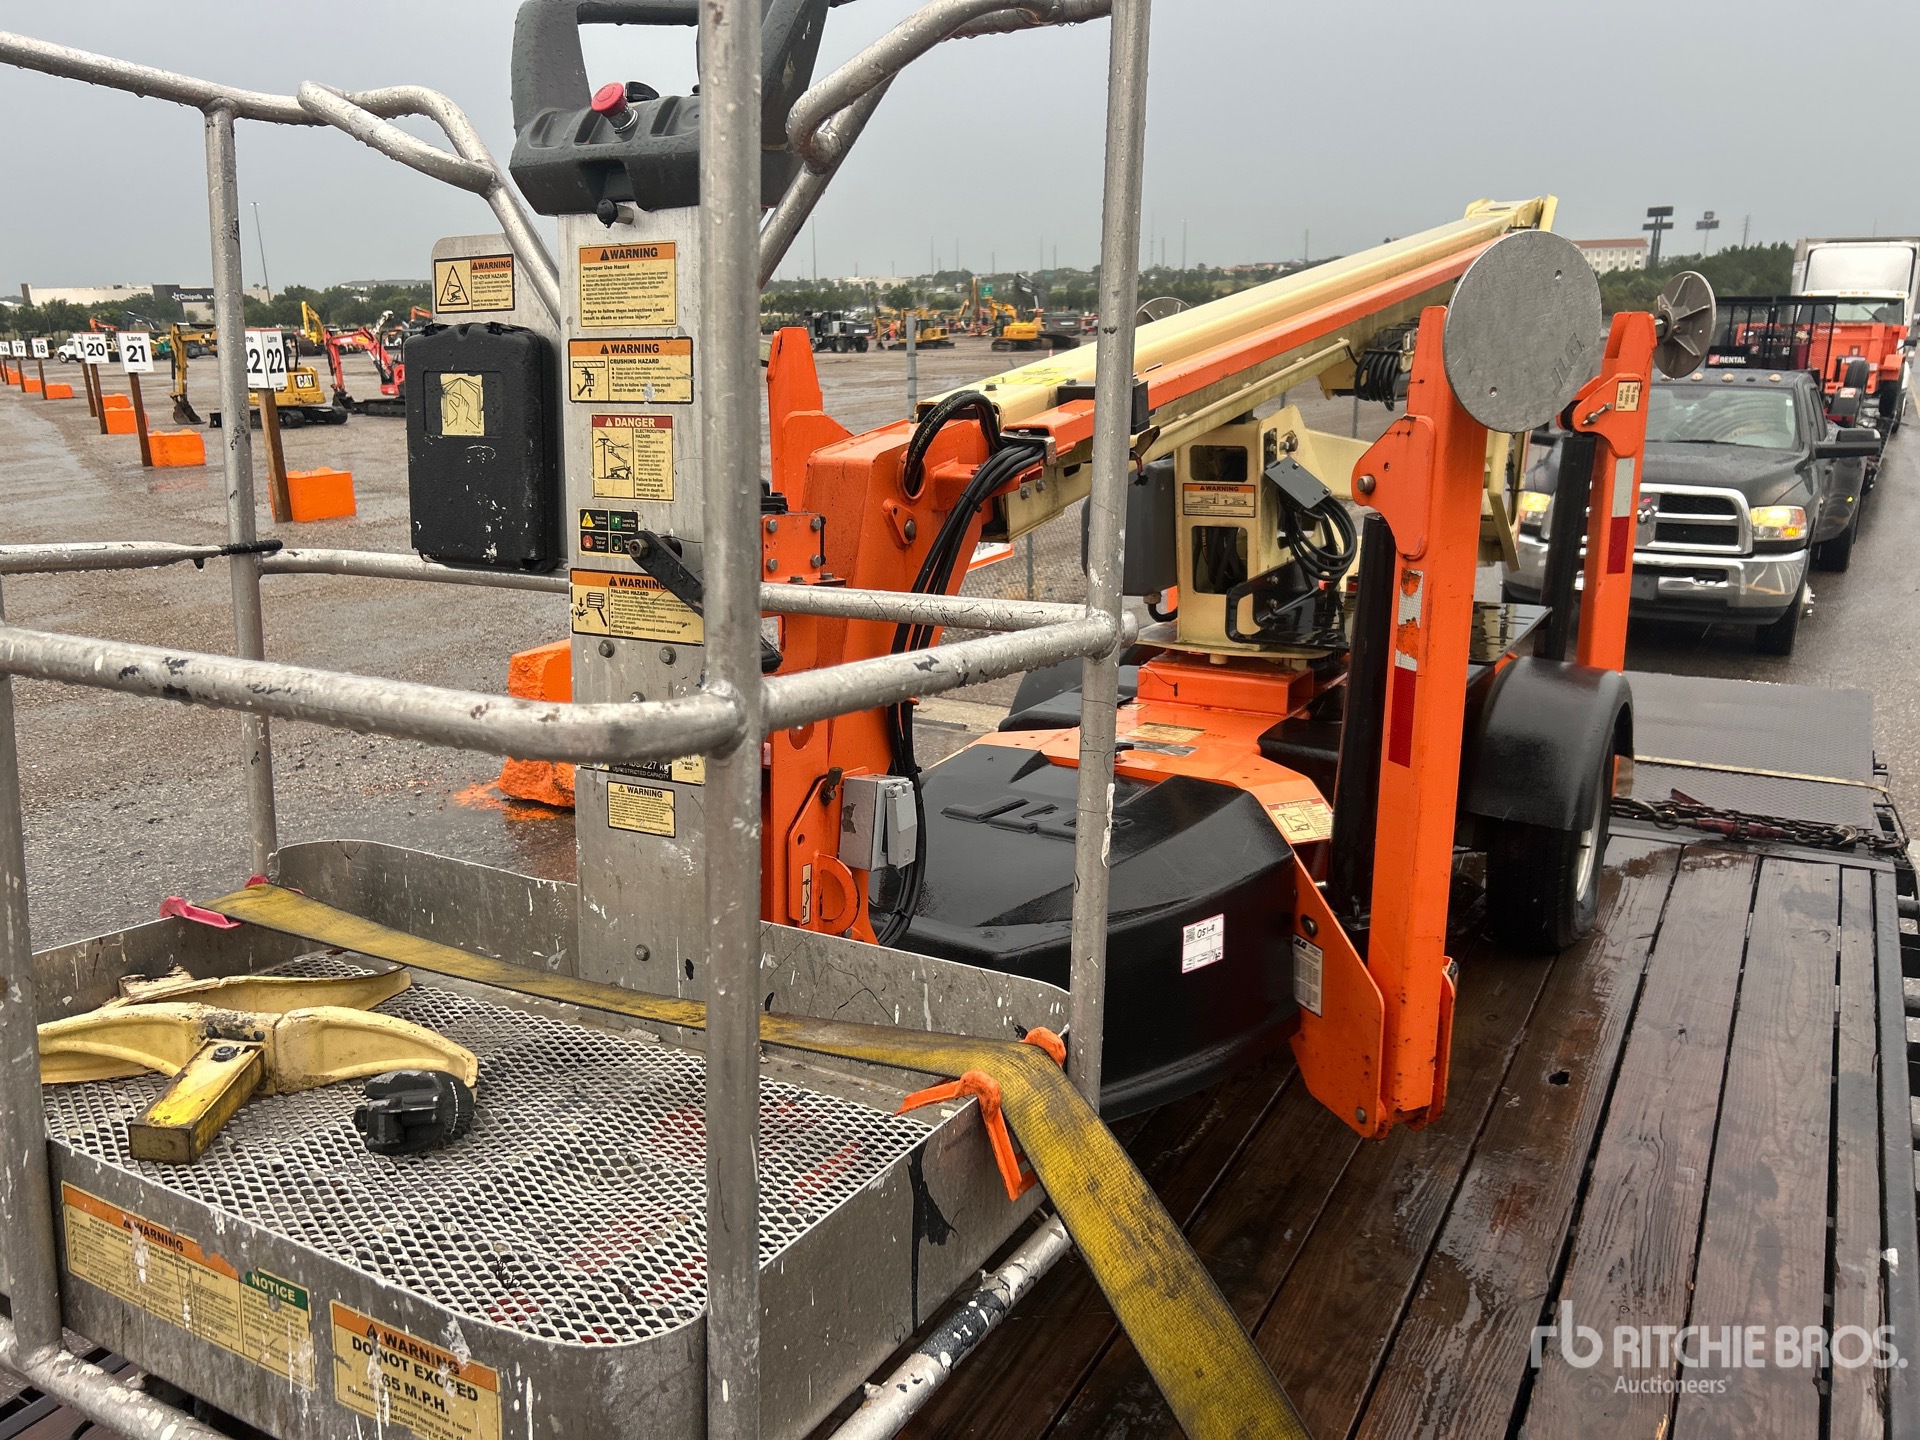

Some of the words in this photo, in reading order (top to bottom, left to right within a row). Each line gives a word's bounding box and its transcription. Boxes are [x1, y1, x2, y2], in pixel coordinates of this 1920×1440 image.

[610, 248, 658, 259] WARNING
[478, 261, 510, 269] WARNING
[35, 344, 45, 353] 18
[86, 343, 105, 356] 20
[126, 345, 146, 362] 21
[611, 344, 660, 354] WARNING
[248, 348, 263, 373] 2
[267, 348, 284, 374] 22
[296, 375, 313, 387] CAT
[615, 418, 655, 427] DANGER
[643, 761, 657, 769] 227
[660, 764, 668, 773] kg
[627, 786, 663, 798] WARNING
[134, 1221, 184, 1252] WARNING
[252, 1273, 295, 1302] NOTICE
[384, 1331, 460, 1375] WARNING
[352, 1336, 372, 1356] DO
[379, 1351, 410, 1372] NOT
[414, 1364, 478, 1402] EXCEED
[381, 1374, 401, 1391] 65
[404, 1383, 450, 1414] M.P.H.
[399, 1405, 417, 1419] could
[390, 1414, 414, 1426] serious
